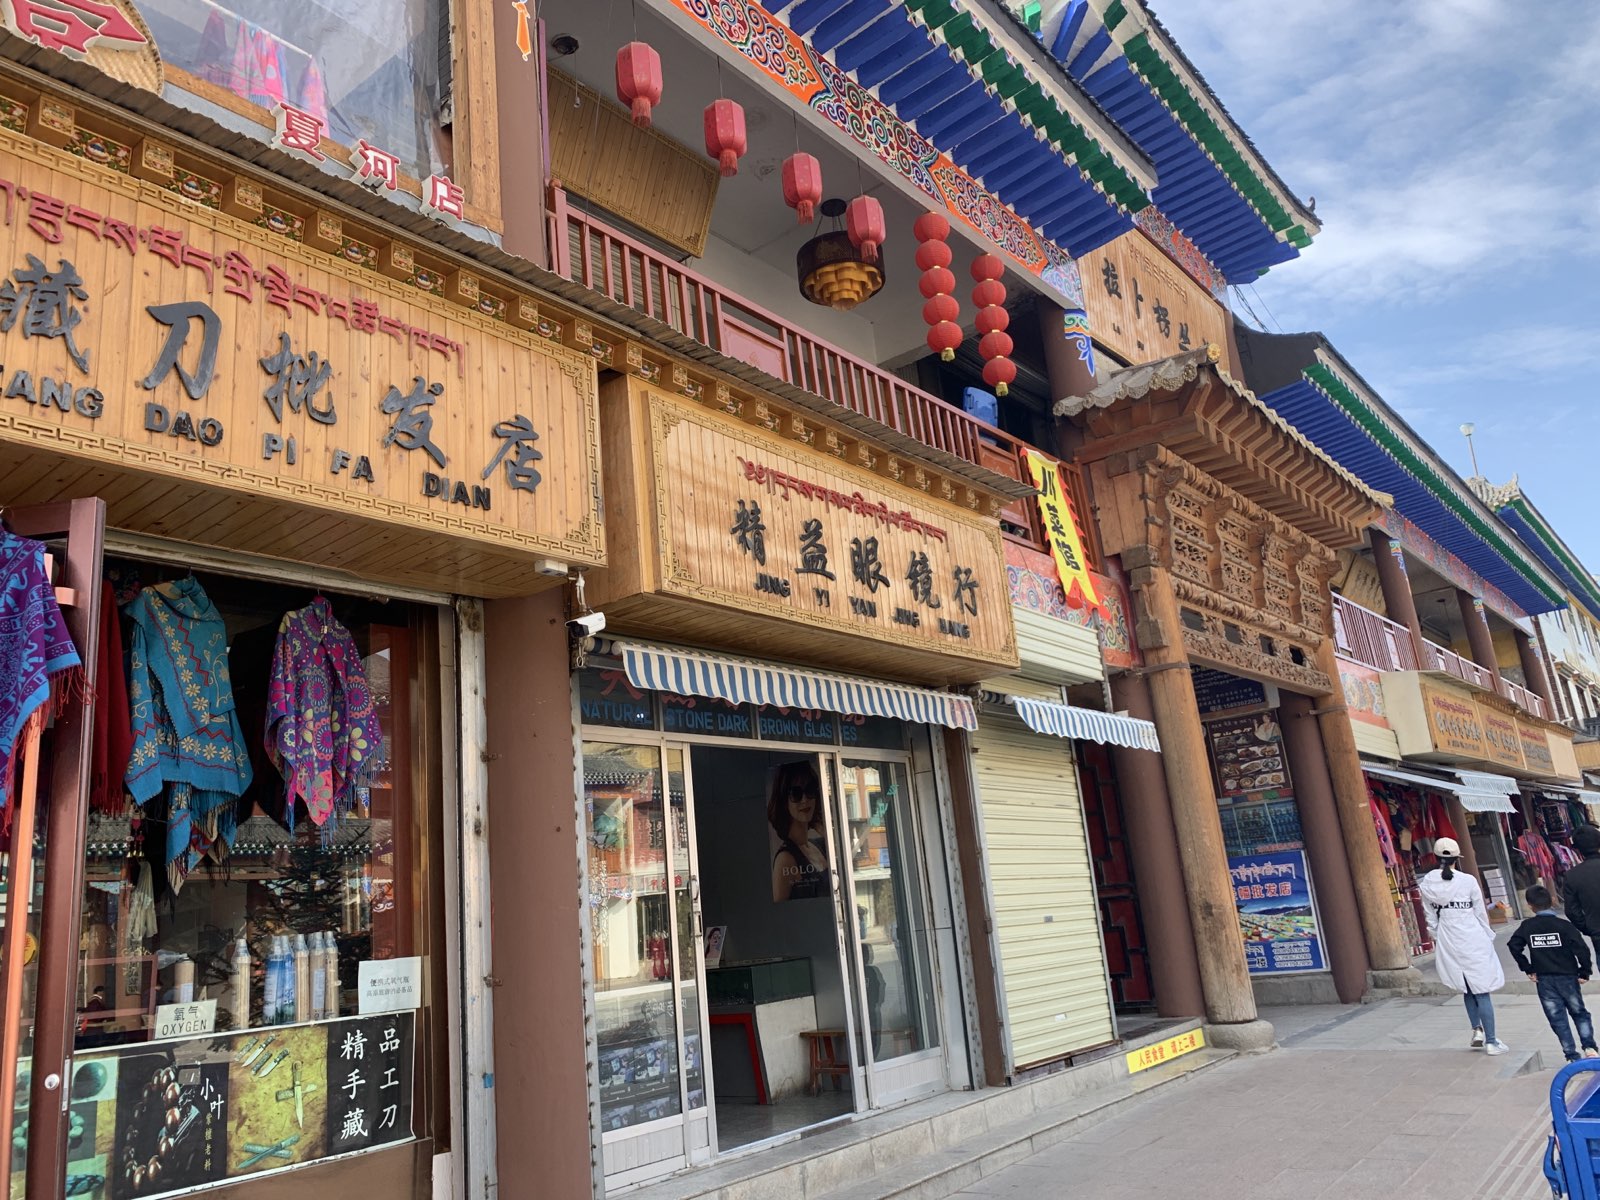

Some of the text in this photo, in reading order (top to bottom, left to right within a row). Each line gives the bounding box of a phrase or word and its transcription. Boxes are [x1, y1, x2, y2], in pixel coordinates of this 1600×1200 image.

[274, 103, 464, 220] 夏河店
[0, 253, 542, 492] 藏刀批发店
[0, 365, 492, 510] ANG DAO PI FA DIAN
[731, 499, 979, 617] 精益眼镜行
[754, 573, 791, 598] JING
[814, 588, 830, 607] YI
[849, 597, 877, 618] YAN
[893, 608, 920, 628] JING
[666, 708, 714, 730] STONE
[719, 713, 750, 732] DARK
[761, 717, 800, 737] BROWN
[804, 721, 857, 741] GLASES
[161, 1020, 208, 1037] OXYGEN
[174, 1005, 199, 1022] 氧气
[200, 1077, 224, 1120] 小叶
